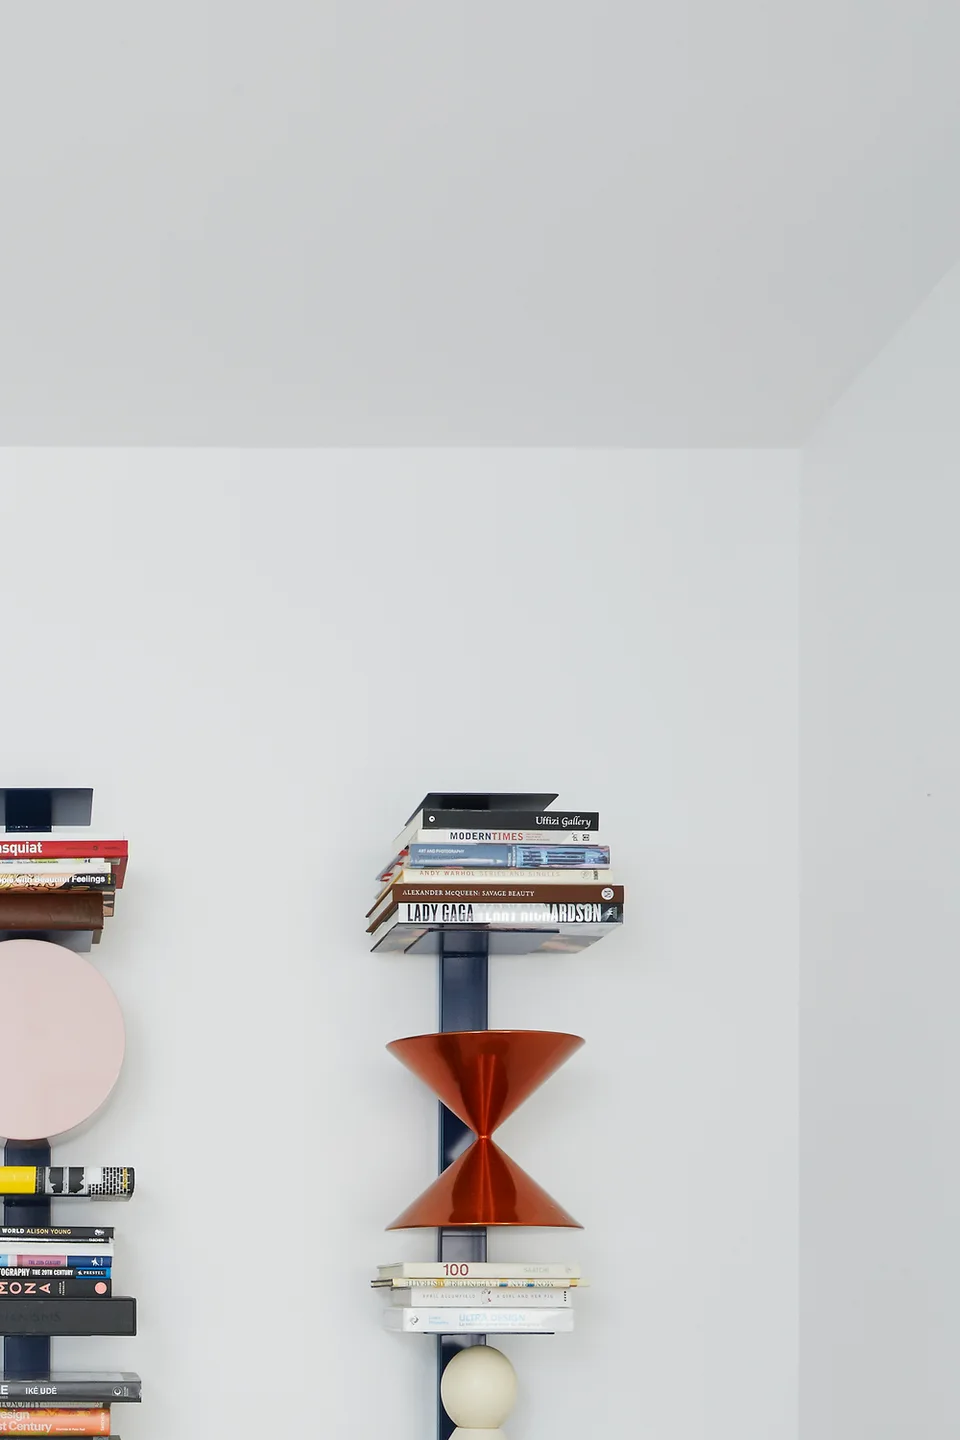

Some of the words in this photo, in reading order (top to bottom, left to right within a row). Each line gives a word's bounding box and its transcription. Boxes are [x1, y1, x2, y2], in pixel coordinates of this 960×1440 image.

[535, 816, 559, 825] Uffizi
[562, 816, 591, 829] Gallery
[408, 904, 438, 922] LADY
[442, 904, 474, 922] GAGA
[443, 1264, 469, 1276] 100
[25, 1386, 38, 1394] IKÉ
[40, 1386, 57, 1394] UDÉ
[8, 1422, 52, 1432] Century
